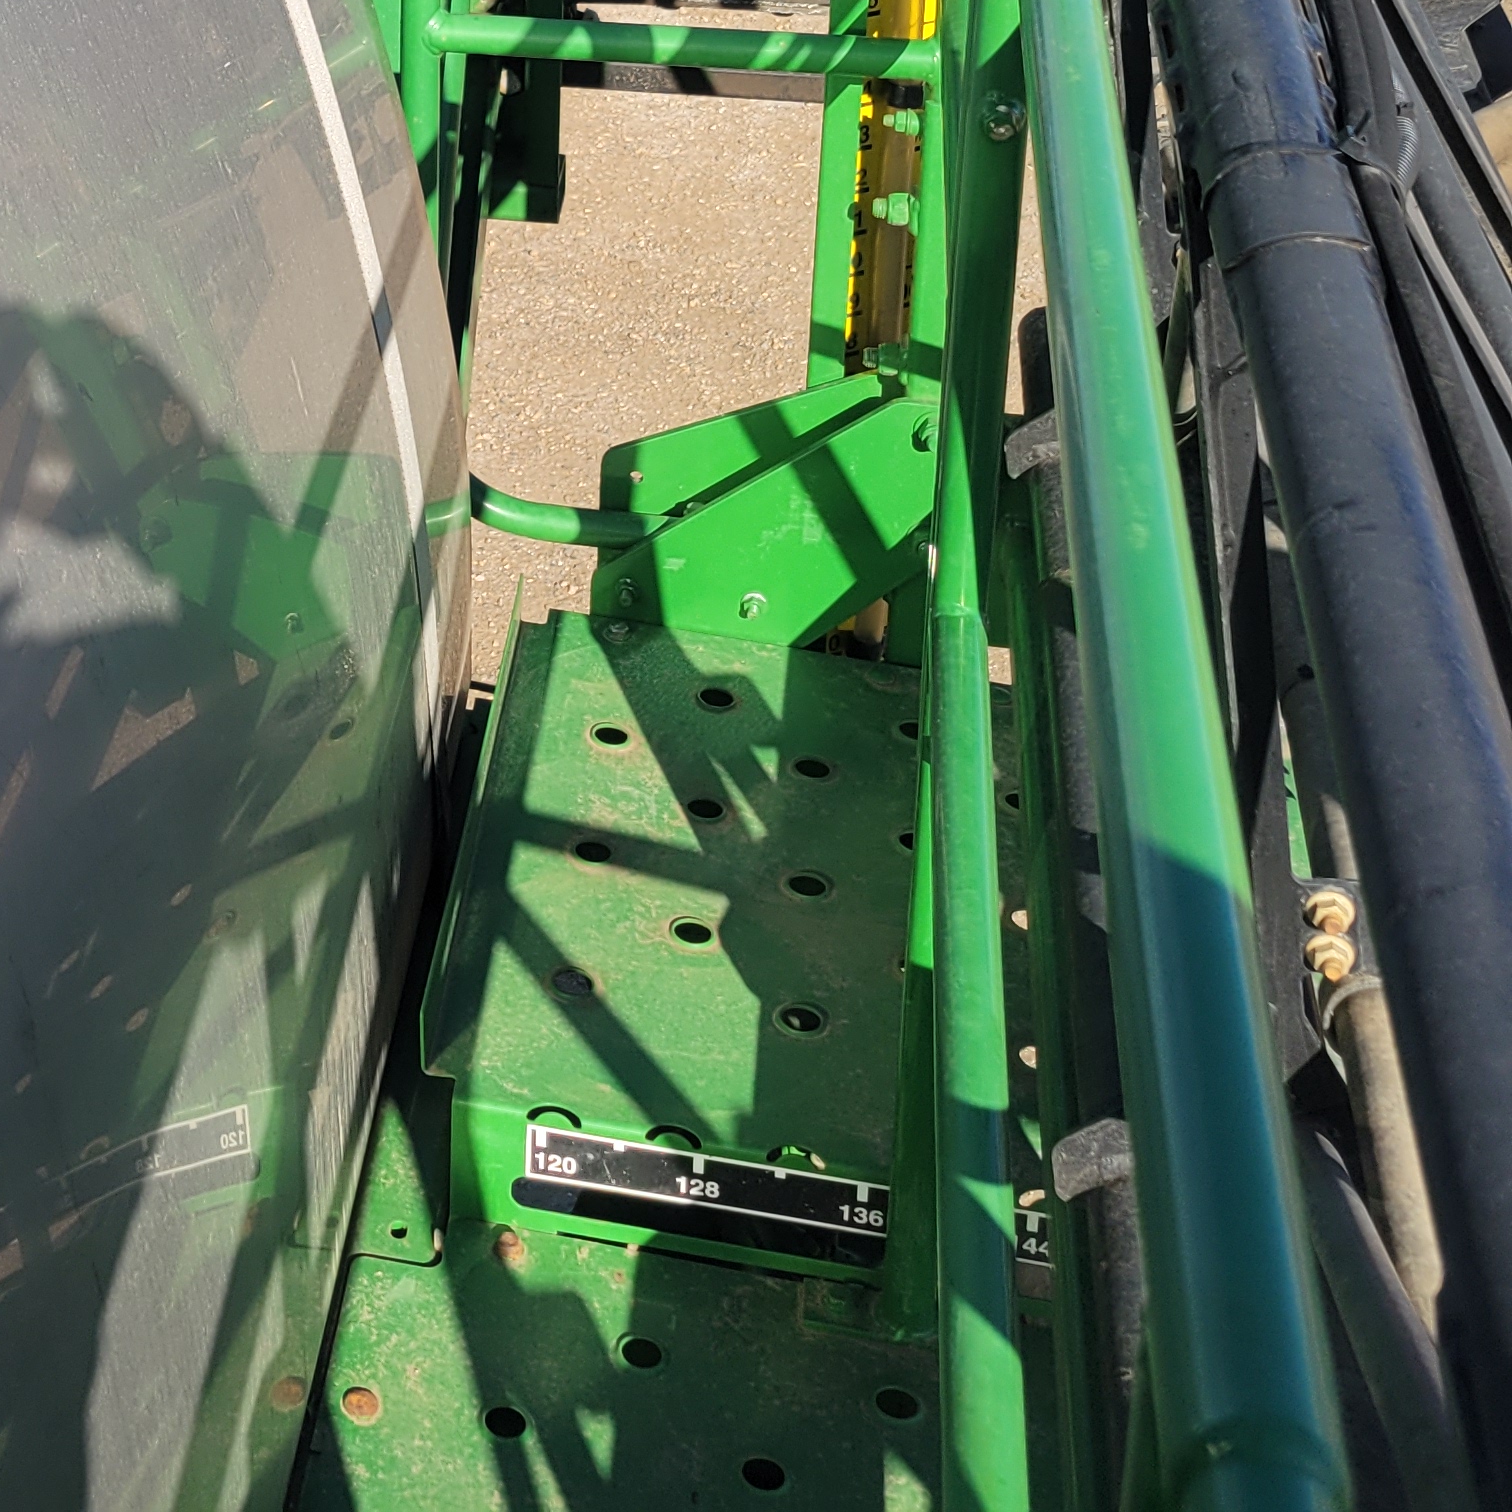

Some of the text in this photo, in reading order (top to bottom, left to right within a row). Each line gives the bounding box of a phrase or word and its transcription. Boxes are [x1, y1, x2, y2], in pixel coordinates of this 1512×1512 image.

[534, 1152, 577, 1175] 120
[675, 1176, 720, 1199] 128
[838, 1204, 885, 1228] 136
